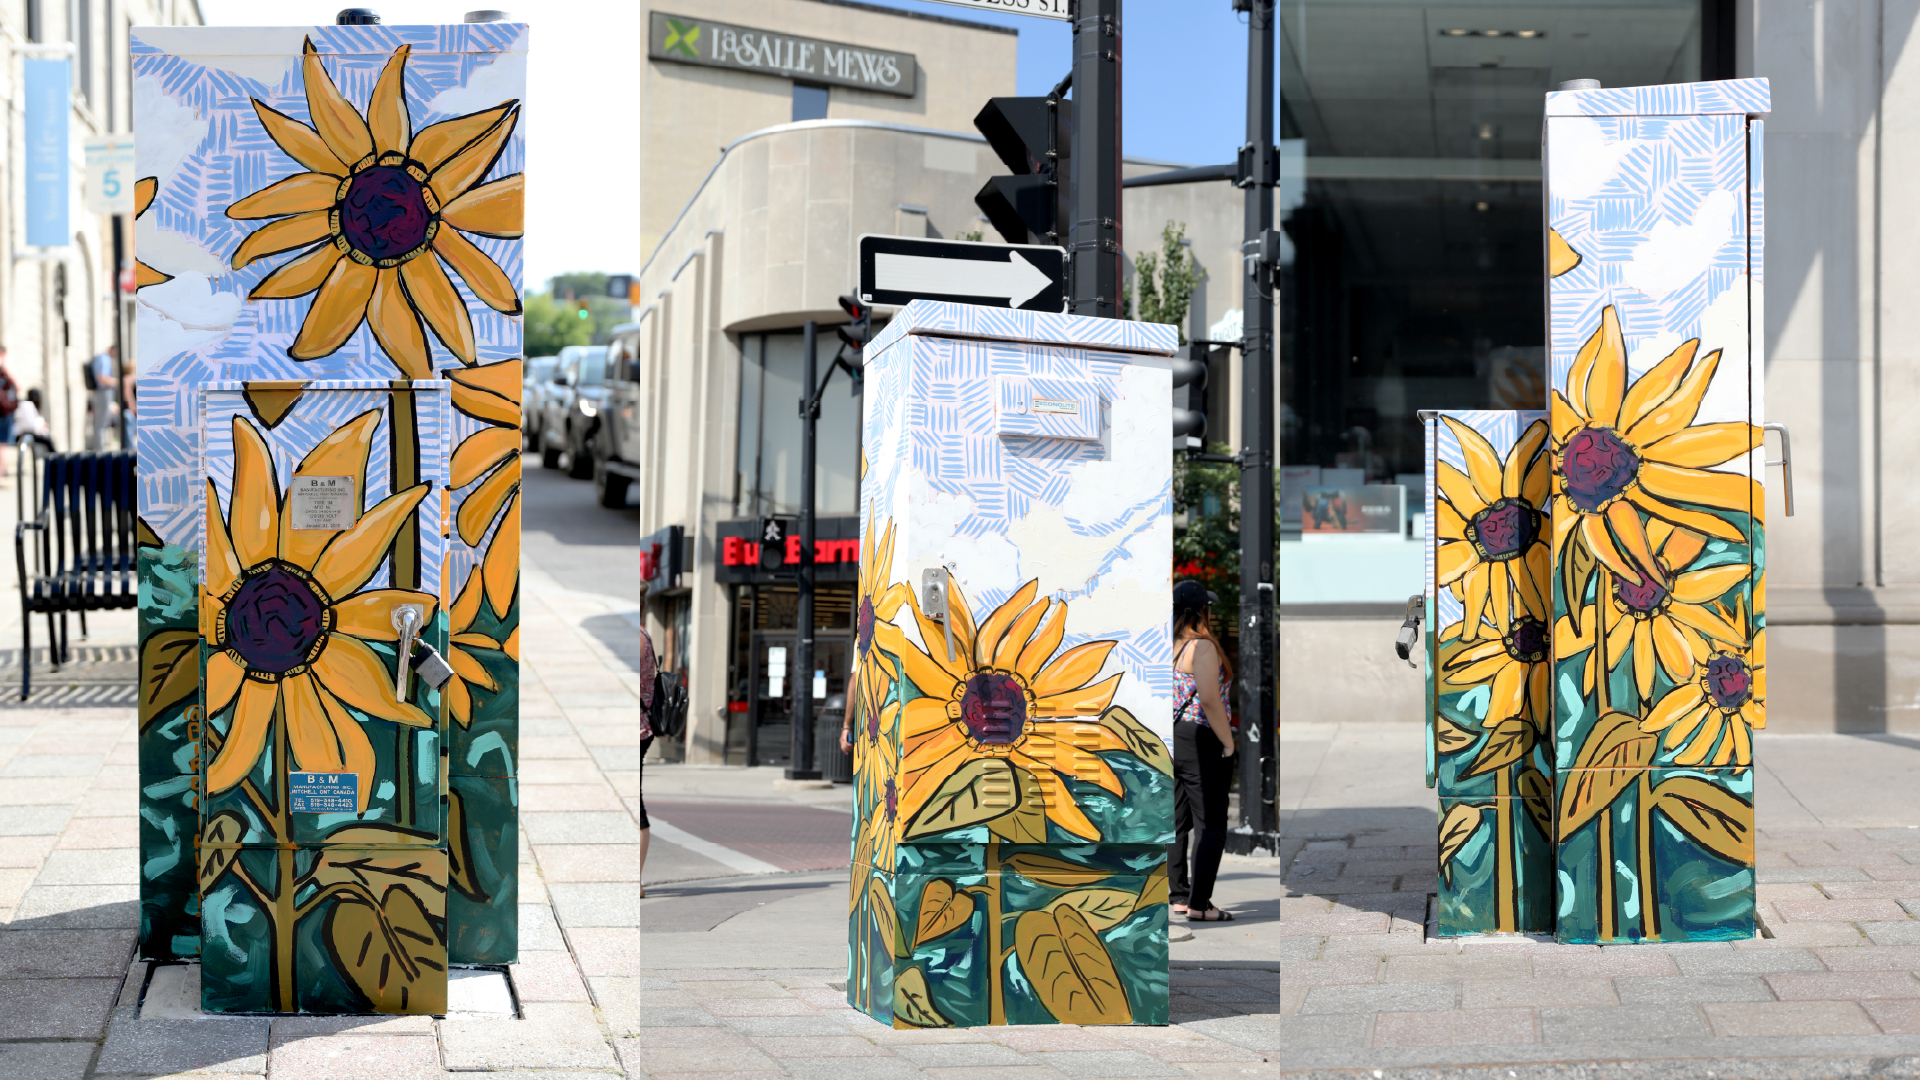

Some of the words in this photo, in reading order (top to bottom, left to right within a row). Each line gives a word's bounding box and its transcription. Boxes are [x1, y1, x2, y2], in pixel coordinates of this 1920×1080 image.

[823, 46, 901, 87] MEWS
[102, 170, 121, 198] 5
[723, 537, 761, 566] Bu
[308, 775, 316, 784] B
[319, 776, 326, 784] &
[328, 775, 339, 784] M
